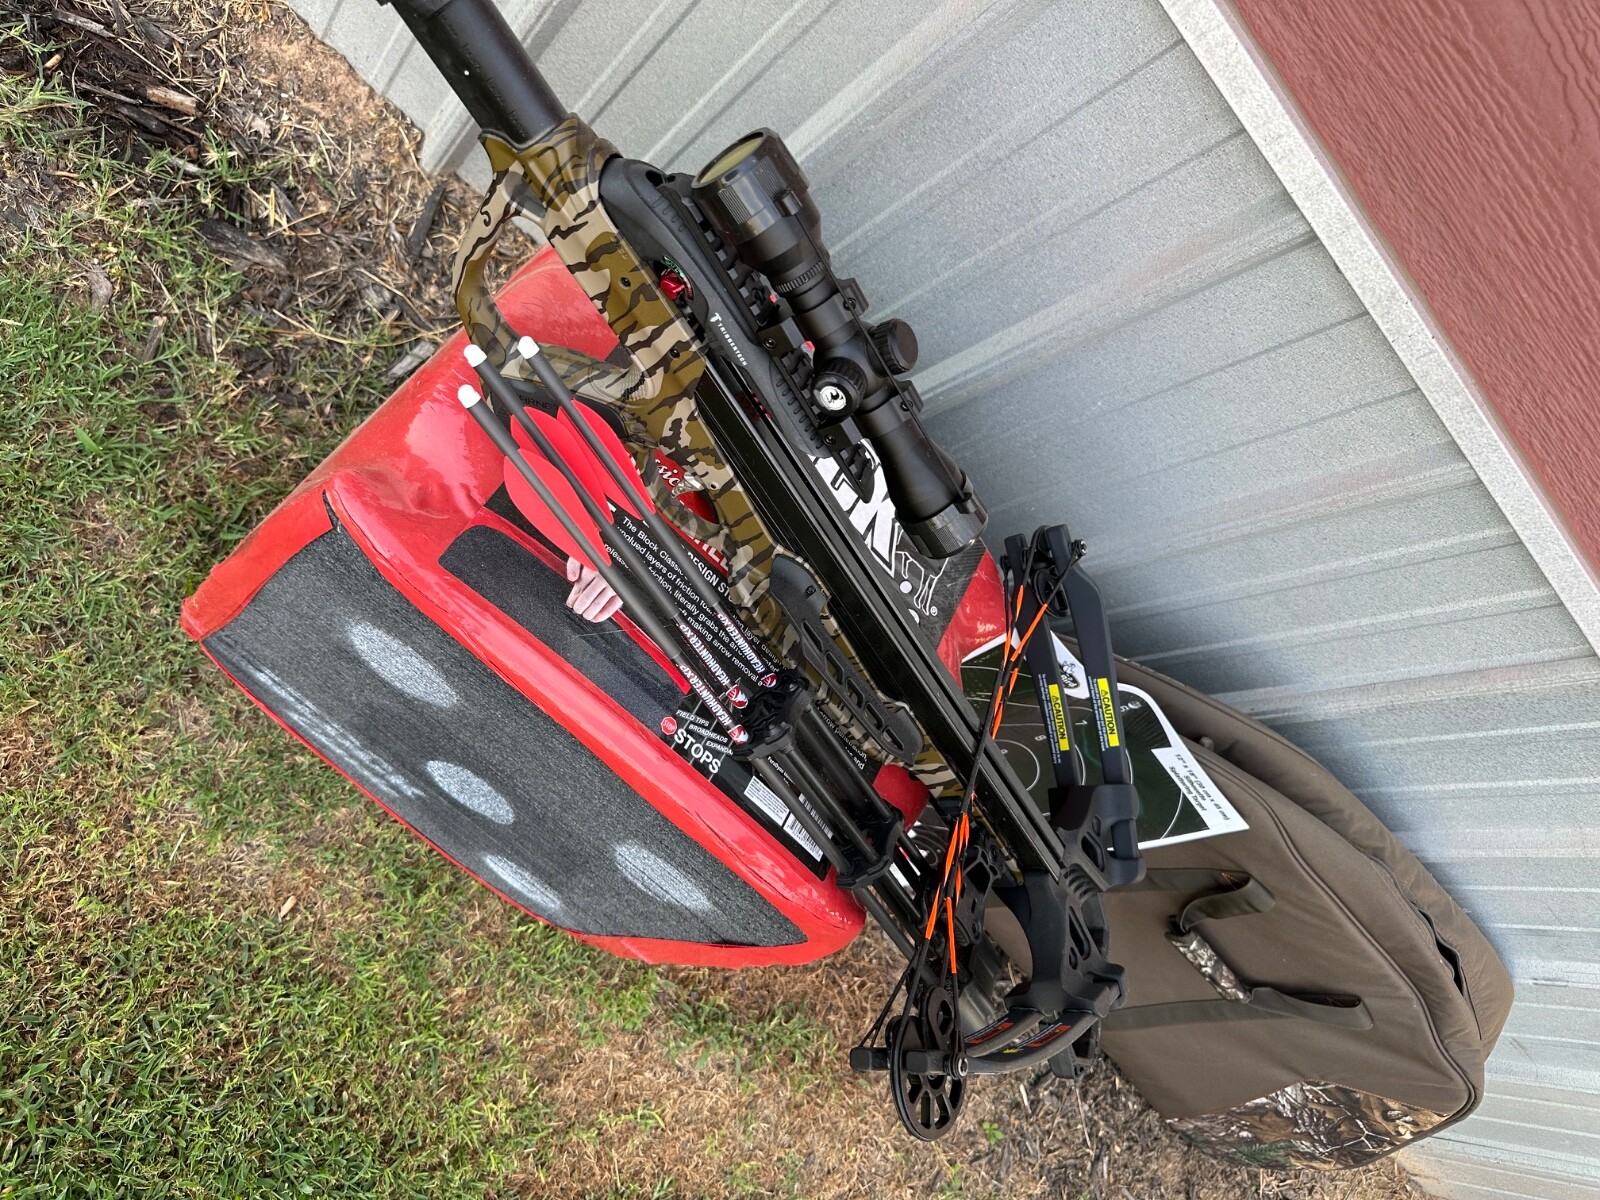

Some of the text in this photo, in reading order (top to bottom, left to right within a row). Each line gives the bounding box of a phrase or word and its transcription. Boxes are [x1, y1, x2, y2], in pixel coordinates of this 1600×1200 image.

[622, 515, 637, 533] The
[636, 530, 659, 552] Block
[644, 550, 667, 573] layers
[666, 572, 677, 580] of
[674, 577, 701, 602] friction
[672, 589, 699, 614] literally
[698, 613, 719, 633] grabs
[718, 630, 729, 642] the
[687, 615, 713, 641] making
[712, 639, 732, 658] arrow
[731, 656, 759, 682] removal
[689, 634, 730, 686] HEADHUNTER
[727, 623, 766, 674] HEADHUNTER
[675, 709, 709, 726] FIELD TIPS
[688, 674, 733, 727] HEADHUNTER
[1053, 702, 1065, 739] CAUTION
[1102, 696, 1116, 735] CAUTION
[662, 719, 722, 775] STOP STOPS
[688, 723, 728, 743] BROADHEADS
[1191, 794, 1207, 811] Target
